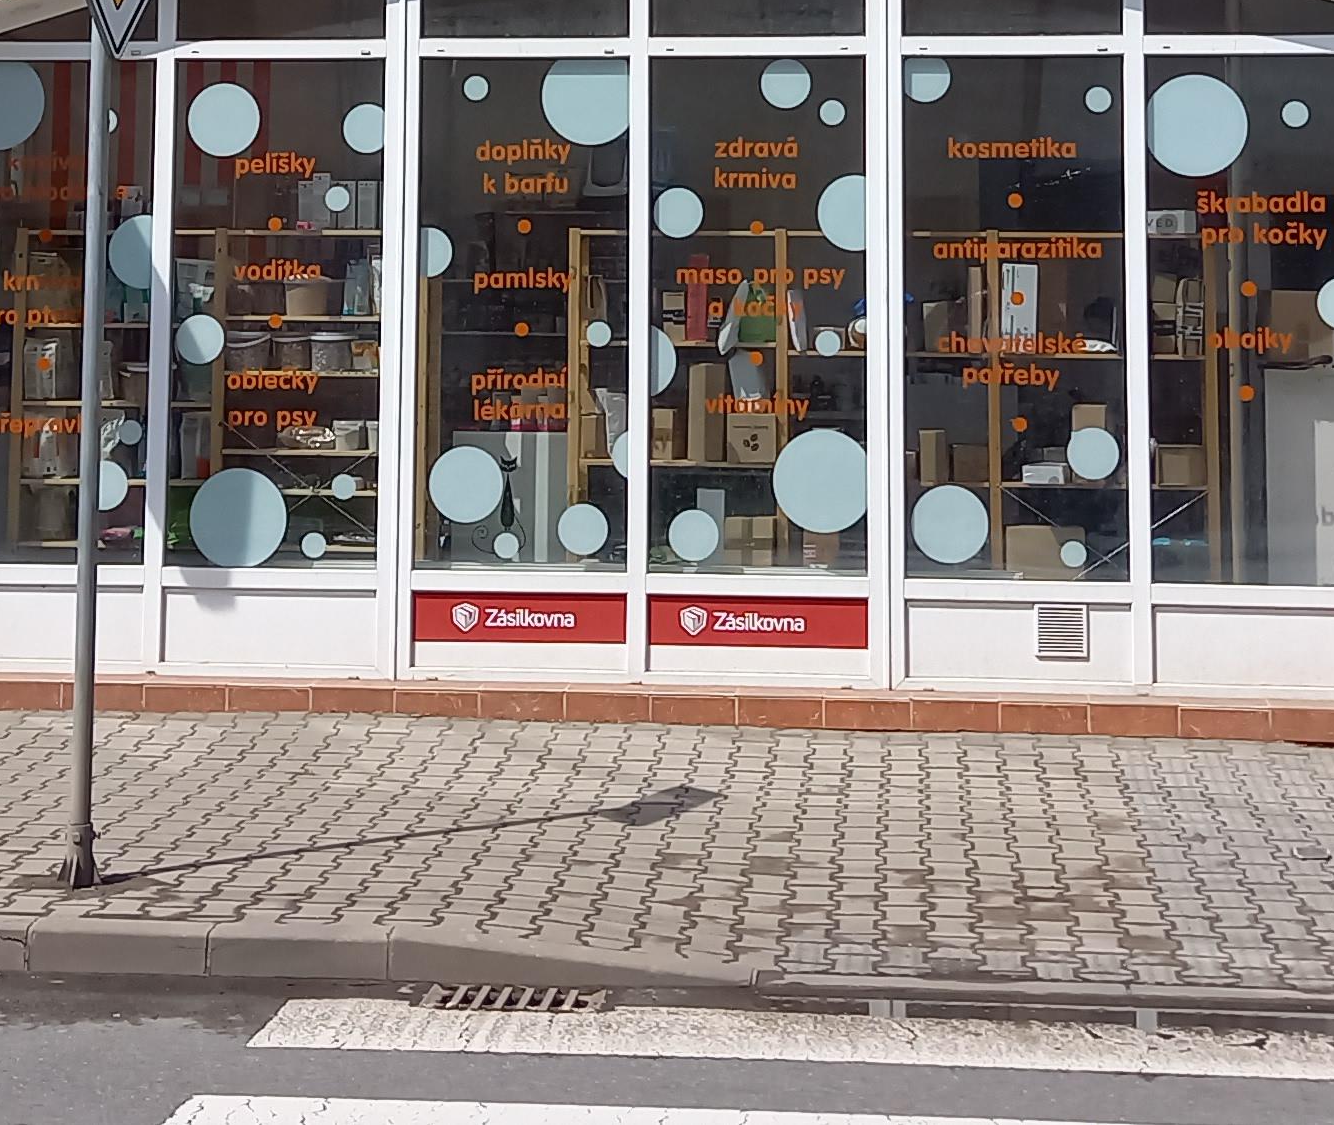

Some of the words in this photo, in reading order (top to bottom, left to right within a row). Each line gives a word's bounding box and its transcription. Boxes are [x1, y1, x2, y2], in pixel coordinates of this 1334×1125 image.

[475, 138, 571, 166] doplňky
[714, 136, 799, 158] zdravá
[948, 136, 1077, 159] kosmetika
[234, 151, 316, 179] pelíšky
[483, 172, 496, 194] k
[504, 171, 568, 194] barfu
[714, 167, 797, 189] krmiva
[1197, 191, 1326, 213] škrabadla
[1202, 226, 1244, 251] pro
[1253, 221, 1327, 251] kočky
[933, 236, 1104, 264] antiparazitika
[234, 259, 322, 281] vodítka
[474, 266, 571, 295] pamlsky
[676, 268, 742, 284] maso
[803, 268, 845, 290] psy
[471, 366, 568, 395] přírodní
[962, 363, 1060, 392] potřeby
[228, 410, 268, 433] pro
[276, 410, 317, 432] psy
[484, 608, 575, 627] Zásilkovna
[712, 612, 805, 632] Zásilkovna
